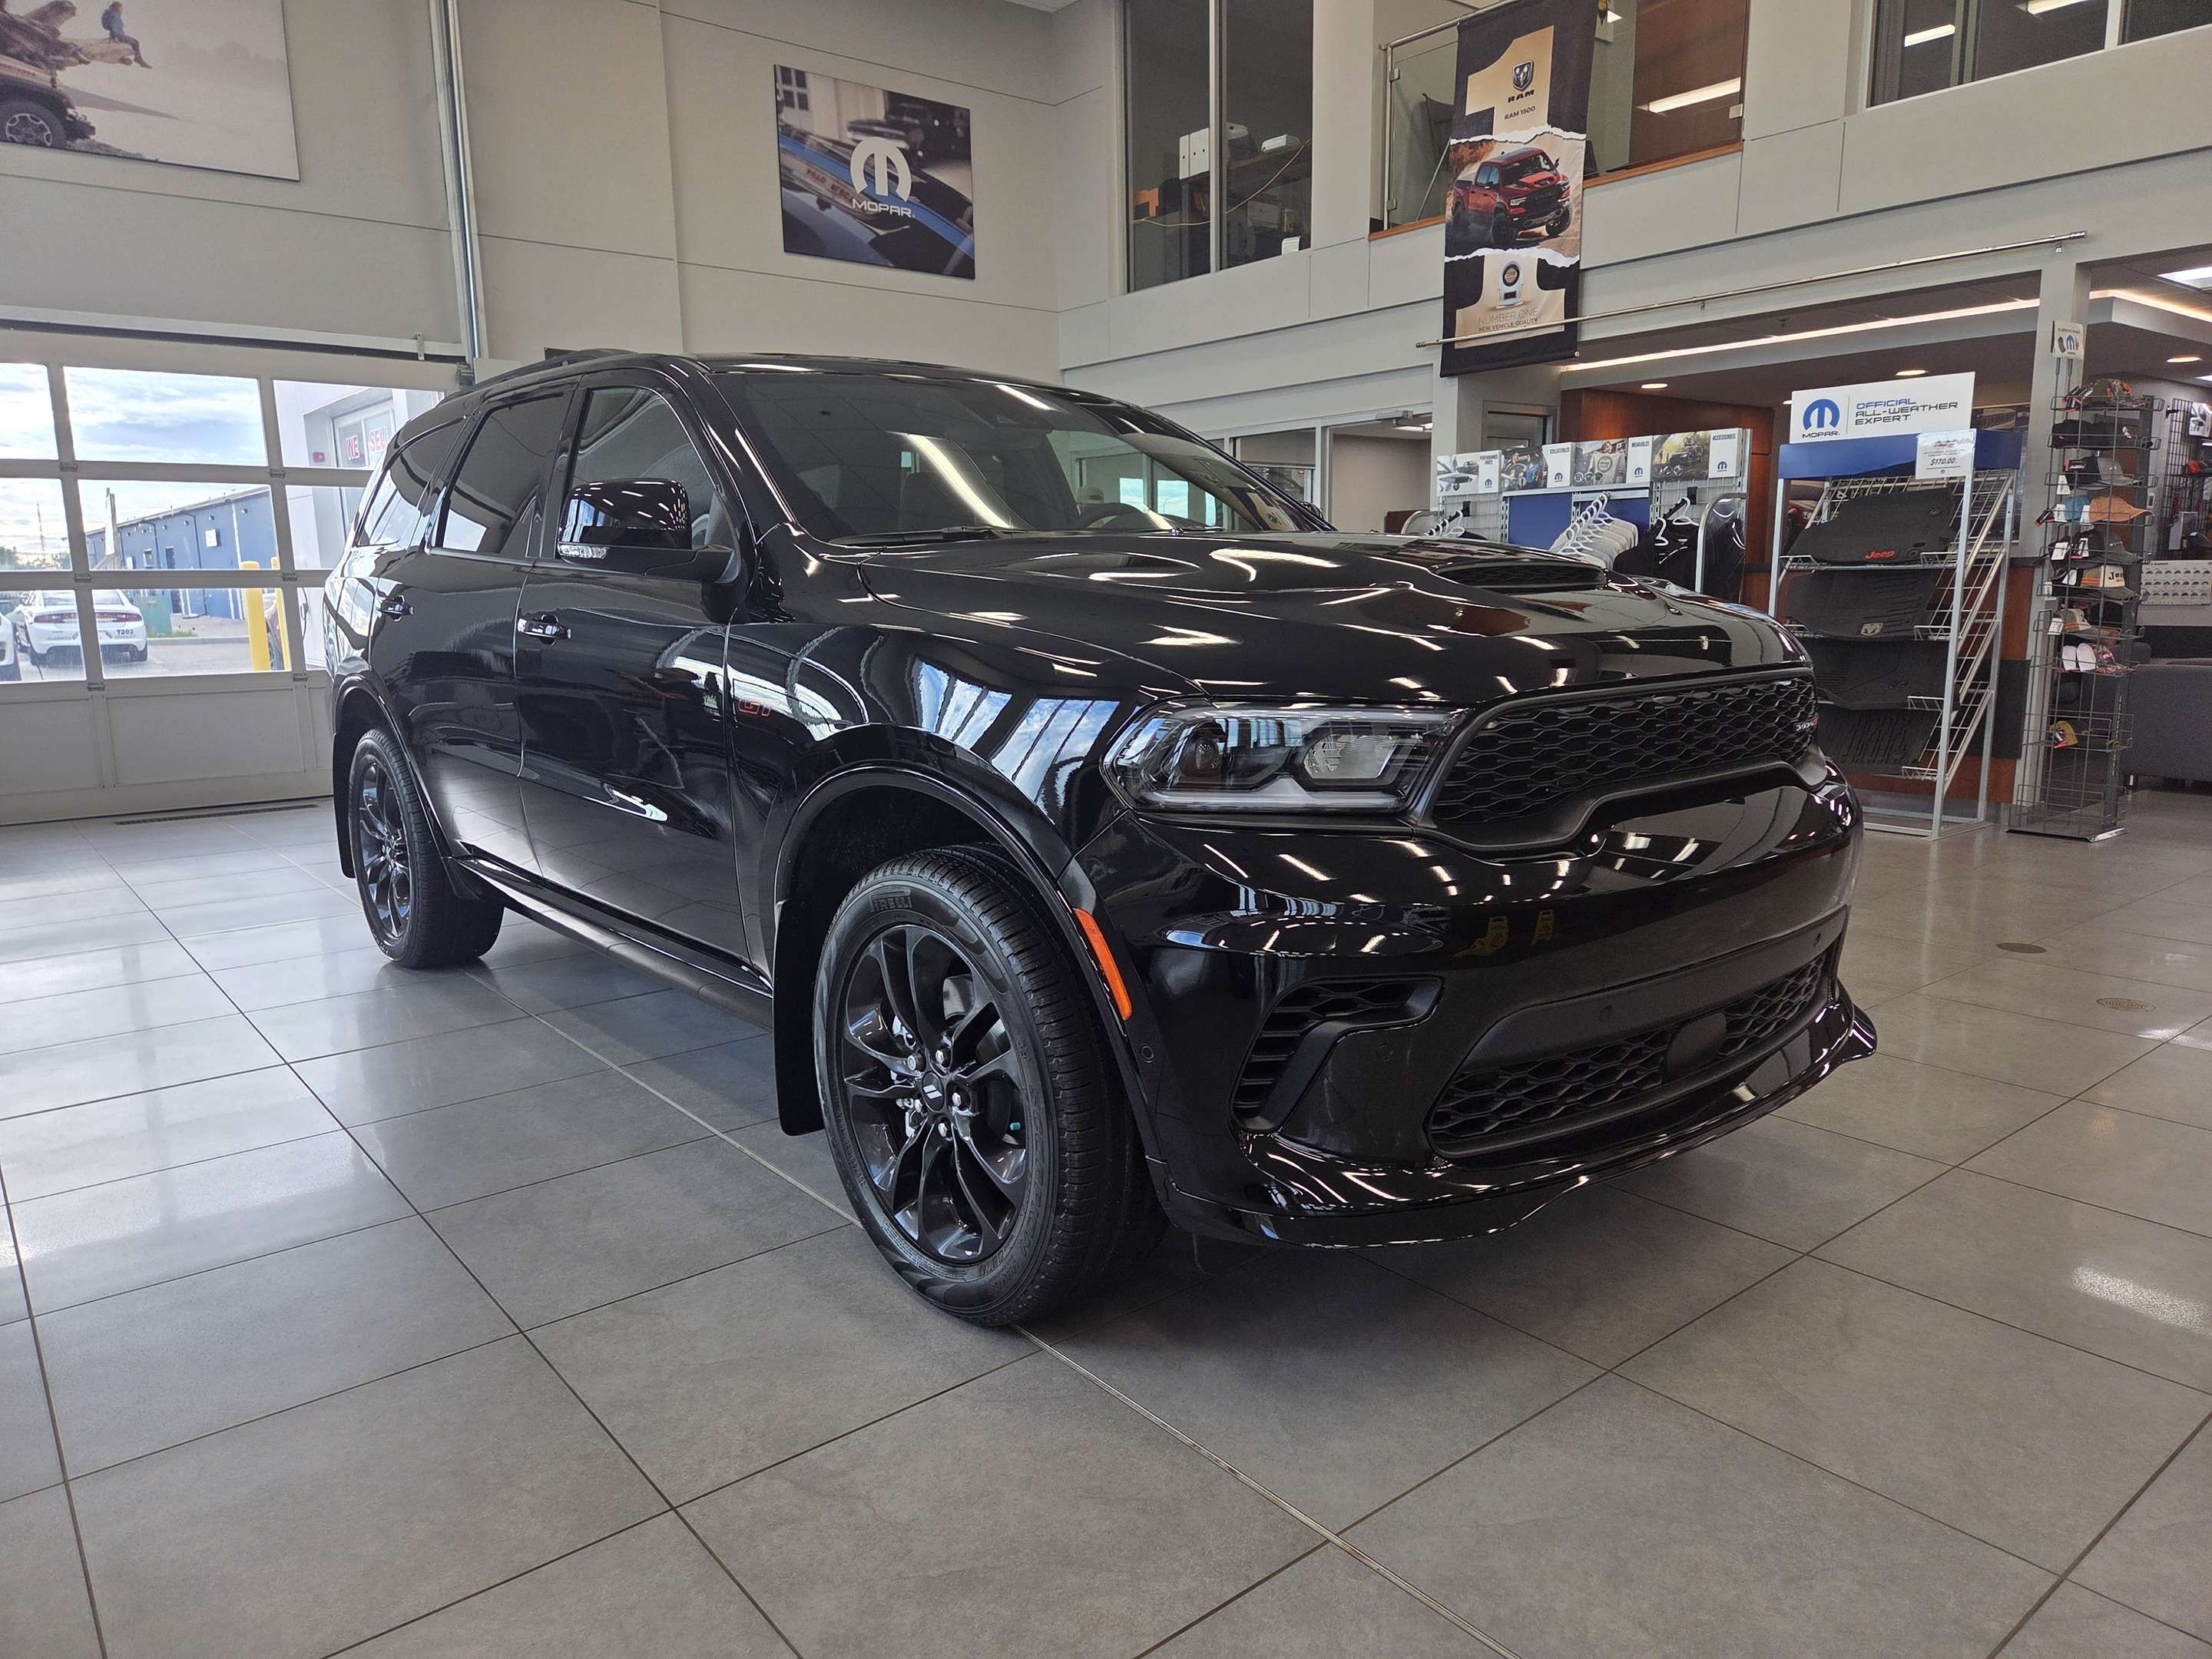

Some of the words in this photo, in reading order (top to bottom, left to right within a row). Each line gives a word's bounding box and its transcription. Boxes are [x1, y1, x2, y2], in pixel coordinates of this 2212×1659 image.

[1508, 90, 1535, 103] RAM
[1504, 111, 1519, 121] RAM
[1520, 106, 1536, 115] 1500
[852, 198, 914, 218] MOPAR
[1478, 311, 1516, 326] NUMBER
[1518, 307, 1538, 319] ONE
[1492, 322, 1514, 331] VEHICLE
[1515, 317, 1538, 326] QUALITY
[1856, 398, 1916, 409] OFFICIAL
[1856, 402, 1959, 417] ALL-WEATHER
[1855, 414, 1912, 426] EXPERT
[1930, 457, 1956, 466] $170.00
[1865, 548, 1896, 561] Jeep
[737, 694, 781, 717] GT
